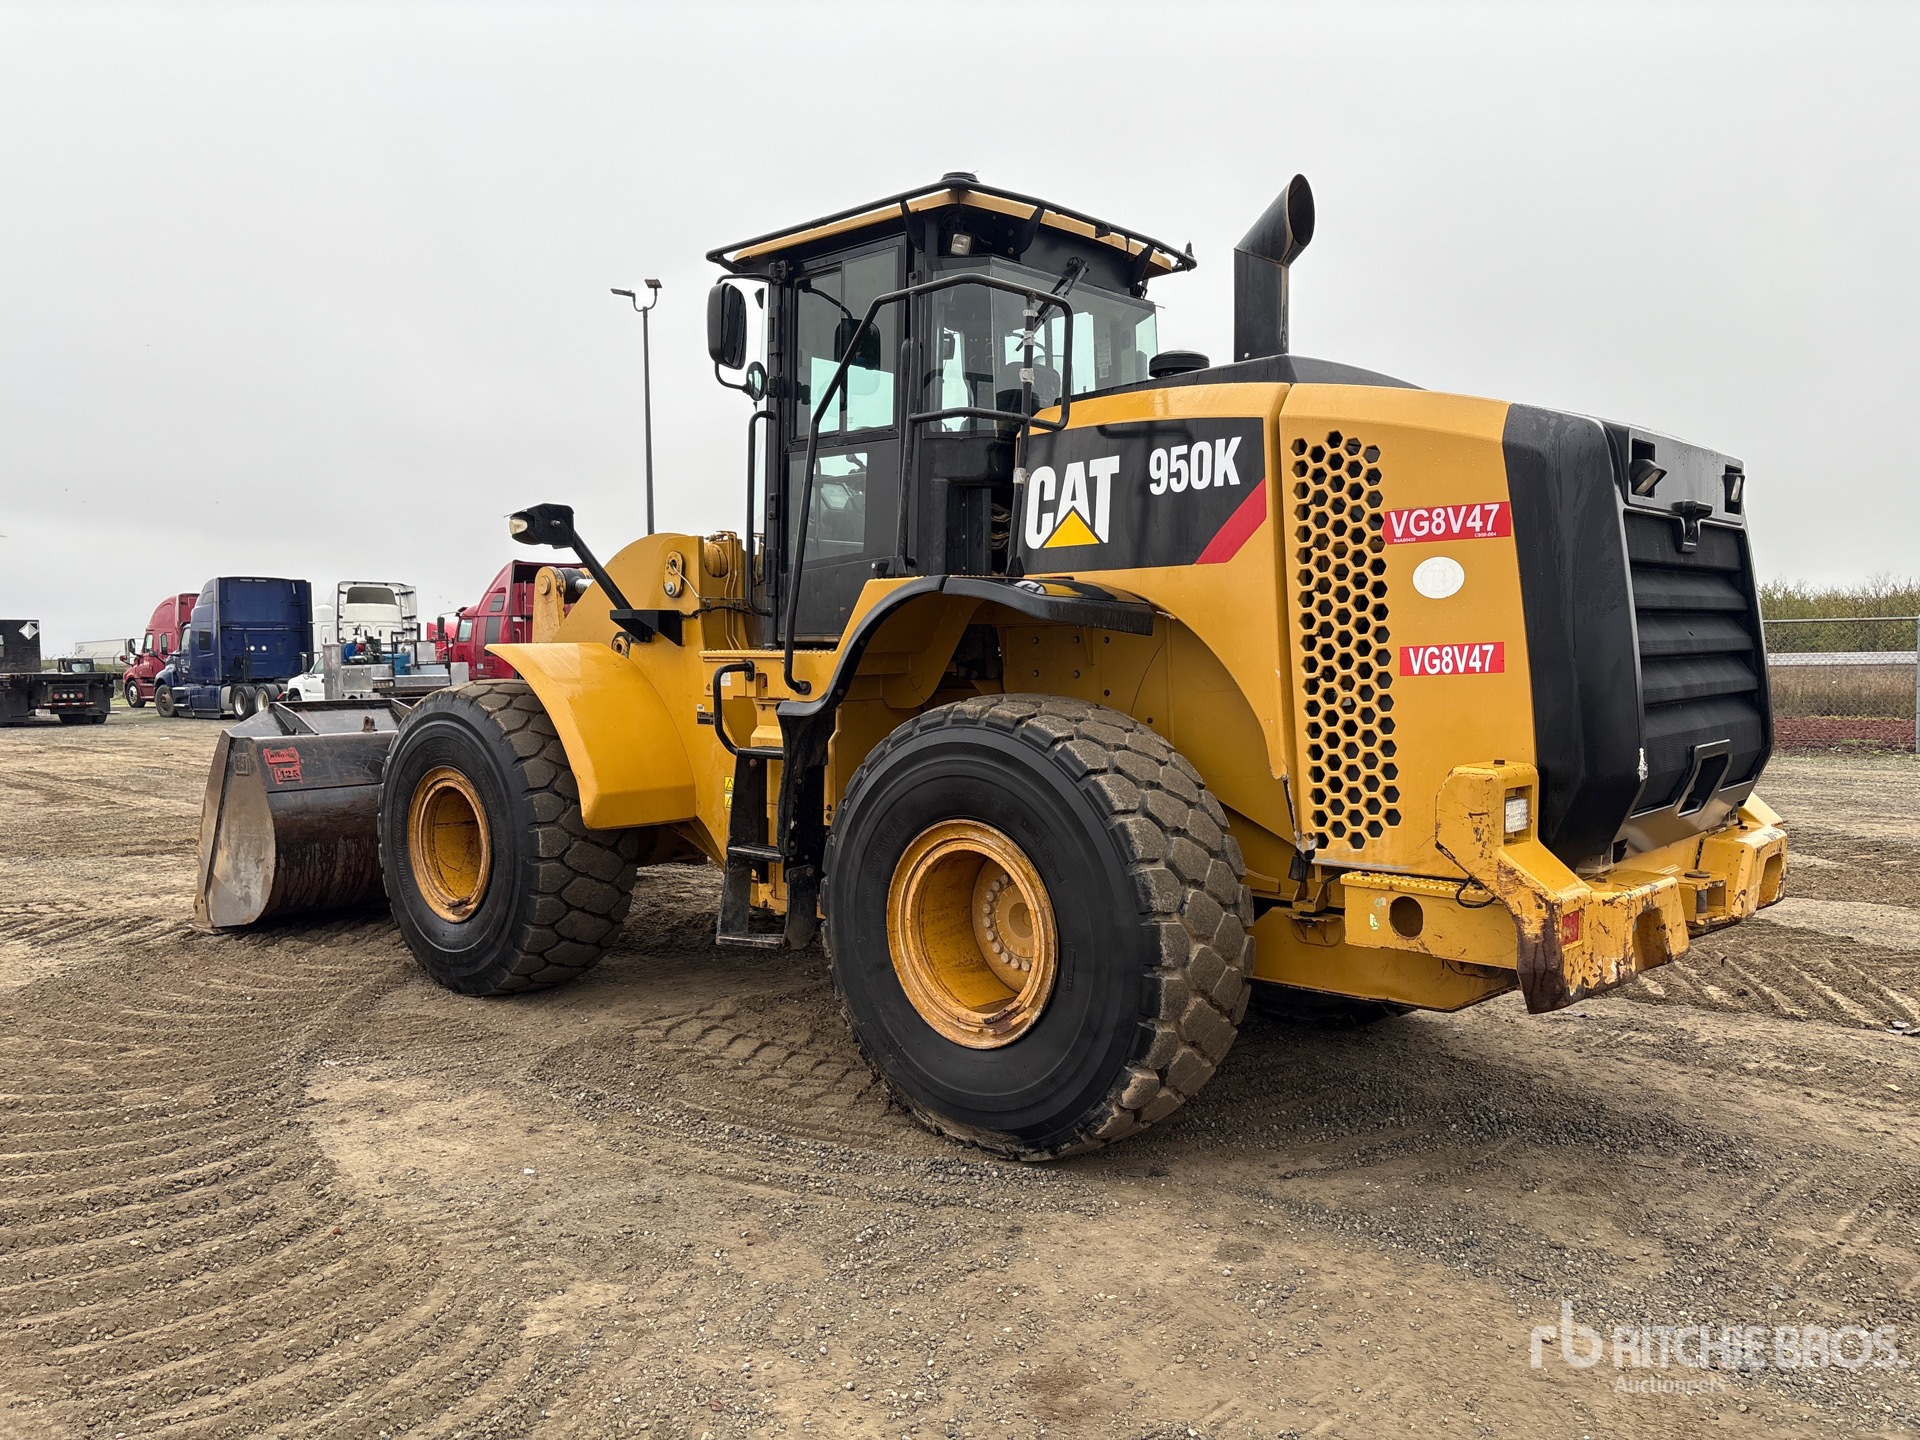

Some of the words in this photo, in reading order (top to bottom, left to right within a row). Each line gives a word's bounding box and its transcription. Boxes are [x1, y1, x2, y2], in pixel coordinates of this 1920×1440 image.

[1149, 436, 1242, 496] 950K
[1025, 455, 1120, 549] CAT
[1390, 503, 1500, 538] VG8V47
[1408, 644, 1494, 675] VG8V47
